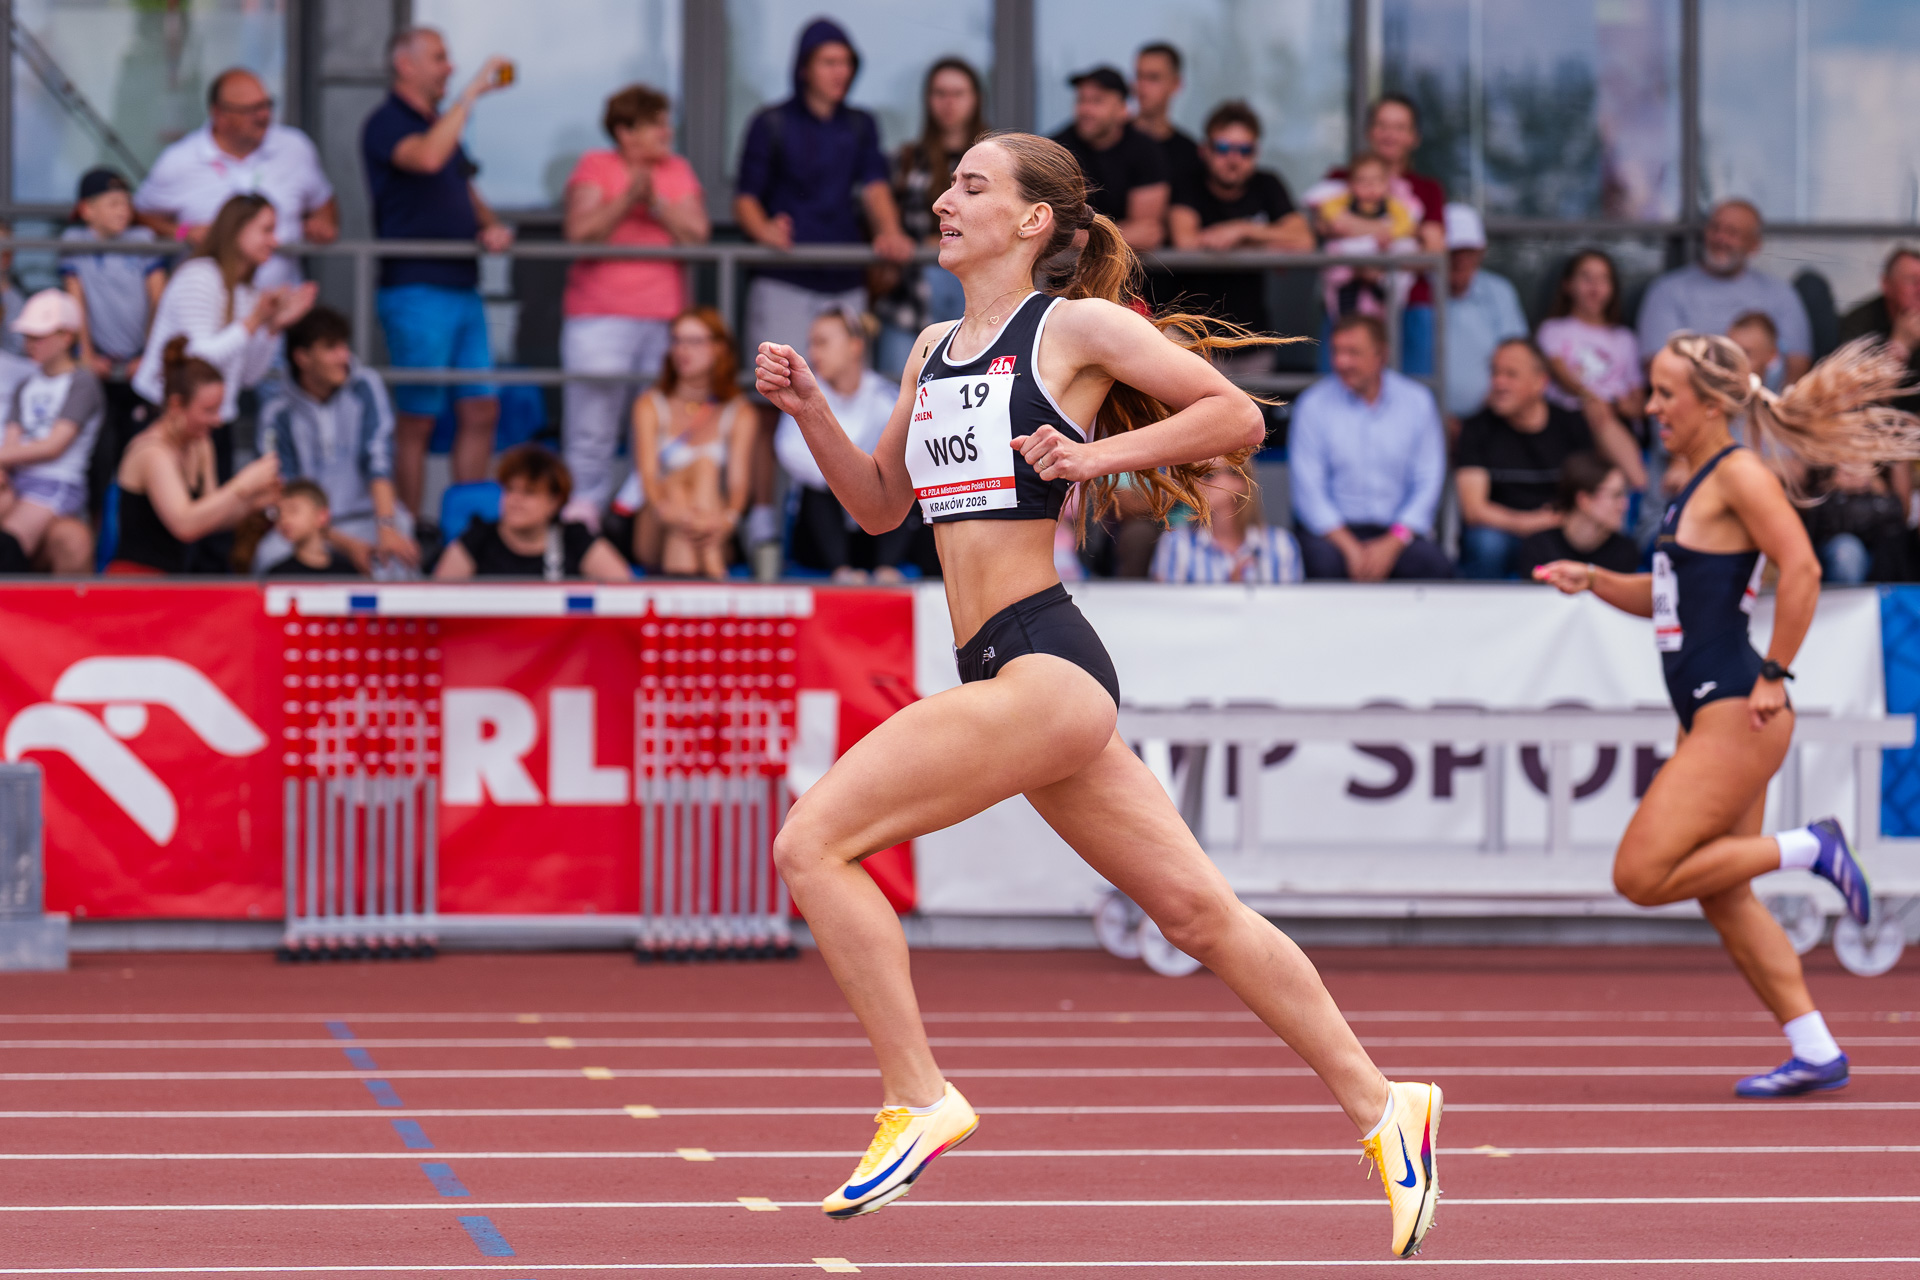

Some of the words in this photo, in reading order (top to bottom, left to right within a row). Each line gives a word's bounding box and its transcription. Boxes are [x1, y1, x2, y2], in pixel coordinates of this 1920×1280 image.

[959, 382, 990, 409] 19
[925, 426, 978, 466] WOŚ
[928, 487, 941, 497] PZLA
[941, 484, 971, 494] Mistrzostwa
[971, 481, 985, 490] Polski
[986, 479, 1001, 488] U23
[930, 497, 964, 513] KRAKÓW
[966, 496, 987, 508] 2026
[1346, 698, 1830, 799] SPO
